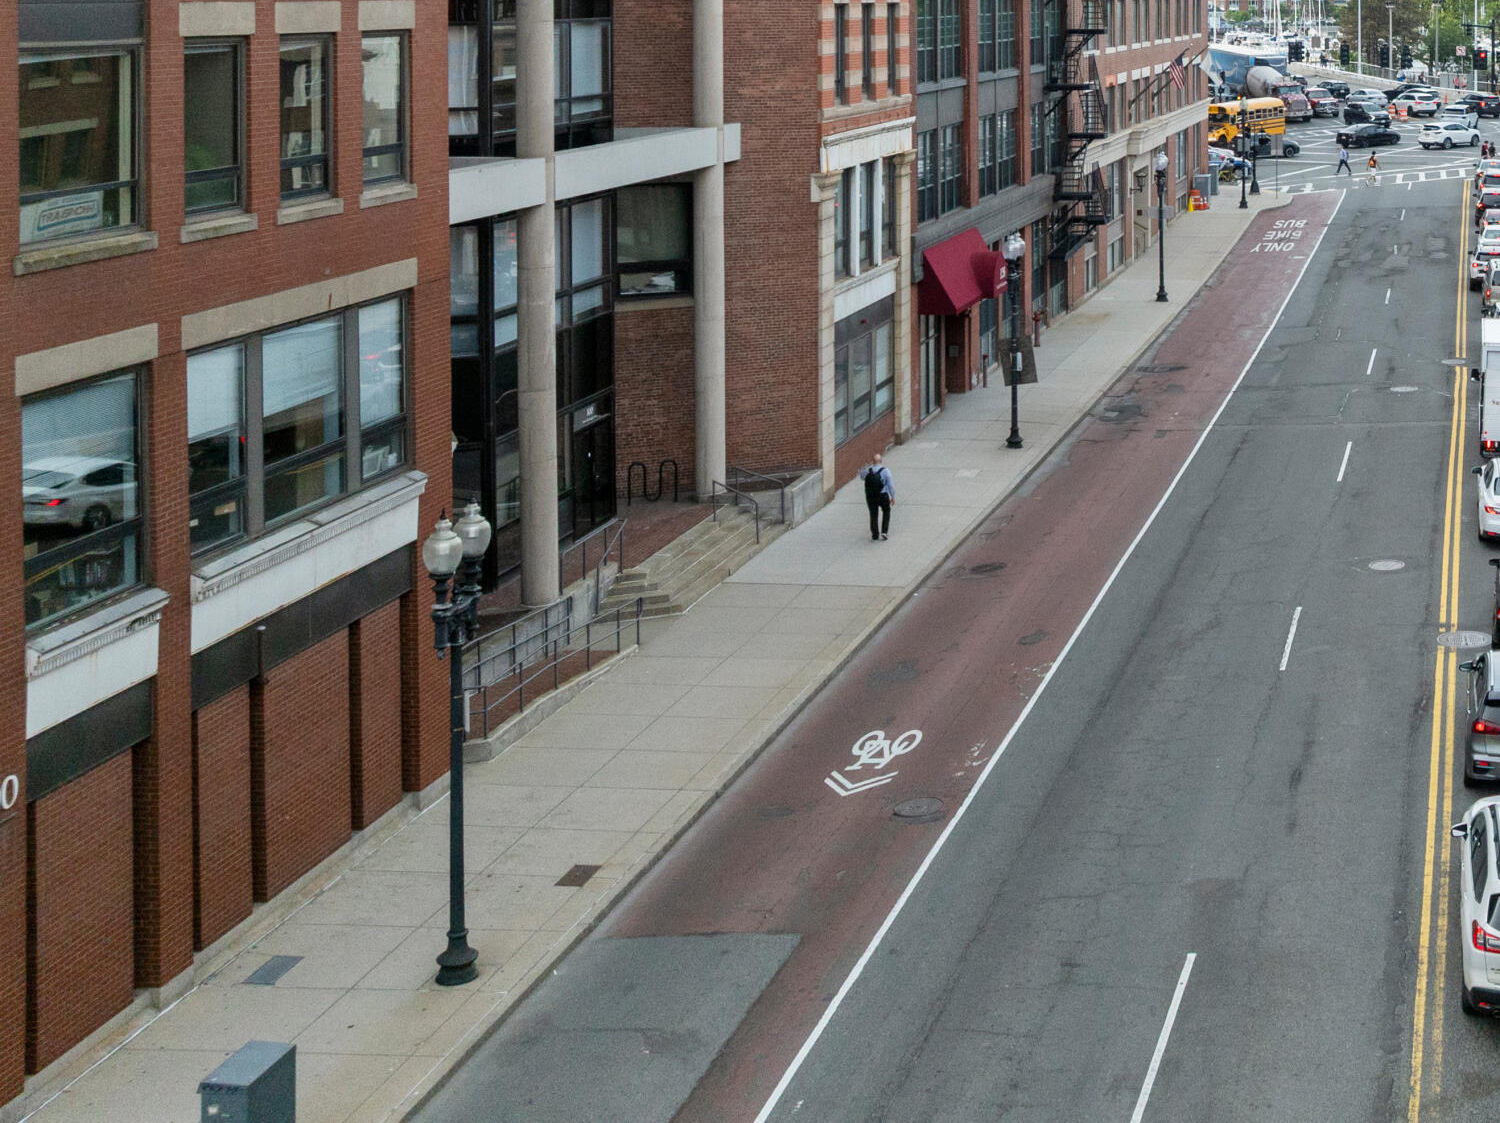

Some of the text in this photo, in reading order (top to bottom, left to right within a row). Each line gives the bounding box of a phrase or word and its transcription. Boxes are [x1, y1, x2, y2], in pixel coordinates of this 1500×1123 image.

[1272, 219, 1307, 228] BUS
[1262, 230, 1302, 240] BIKE
[1249, 242, 1295, 253] ONLY
